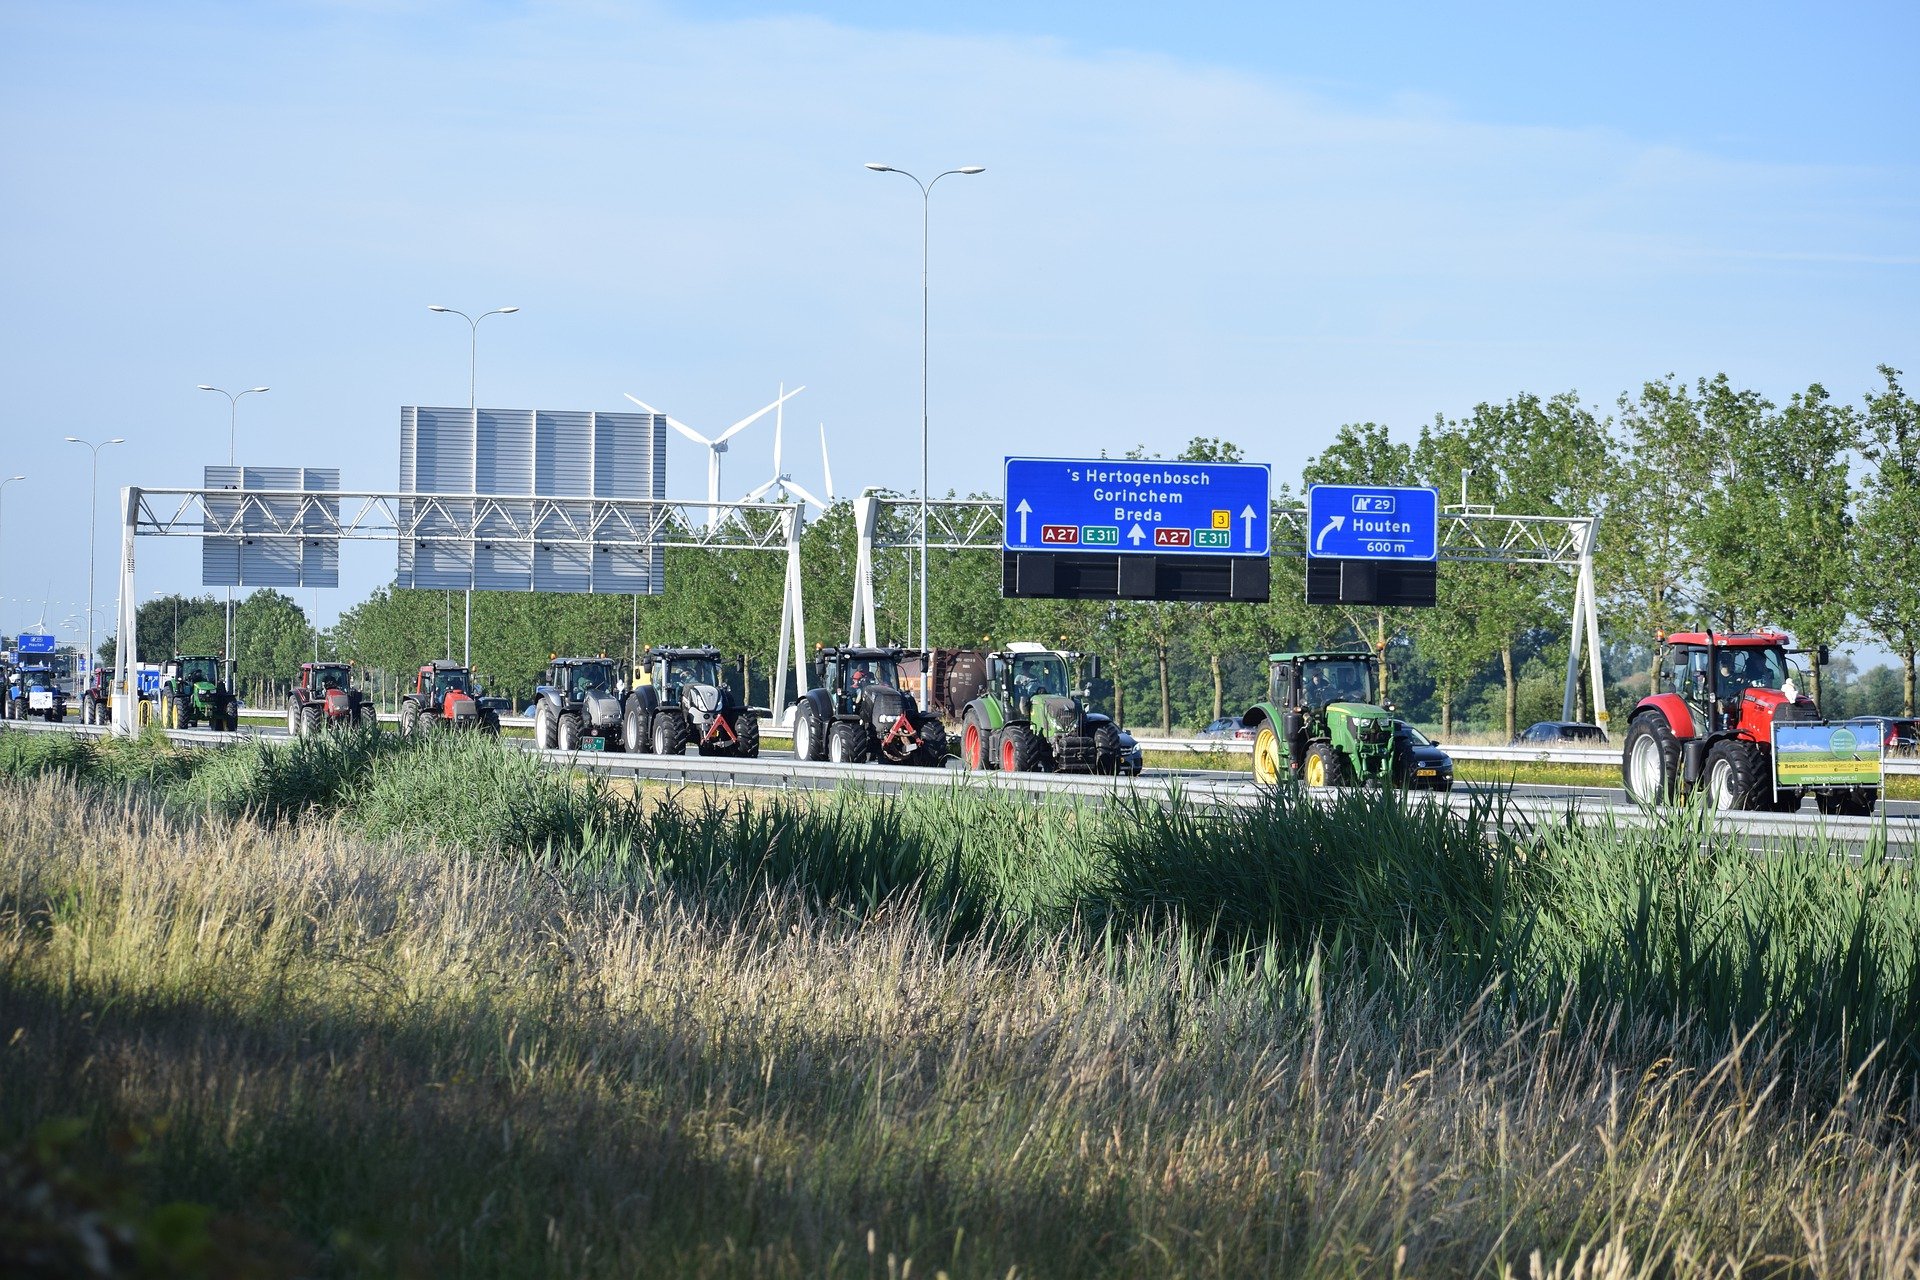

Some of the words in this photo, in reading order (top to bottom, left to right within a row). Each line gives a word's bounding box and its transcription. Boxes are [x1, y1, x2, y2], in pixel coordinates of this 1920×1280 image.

[1086, 469, 1210, 486] Hertogenbosch
[1093, 488, 1183, 504] Gorinchem
[1374, 499, 1390, 510] 29
[1114, 508, 1162, 522] Breda
[1217, 515, 1225, 525] 3
[1353, 519, 1411, 533] Houten
[1367, 542, 1391, 552] 600
[1394, 544, 1405, 552] m
